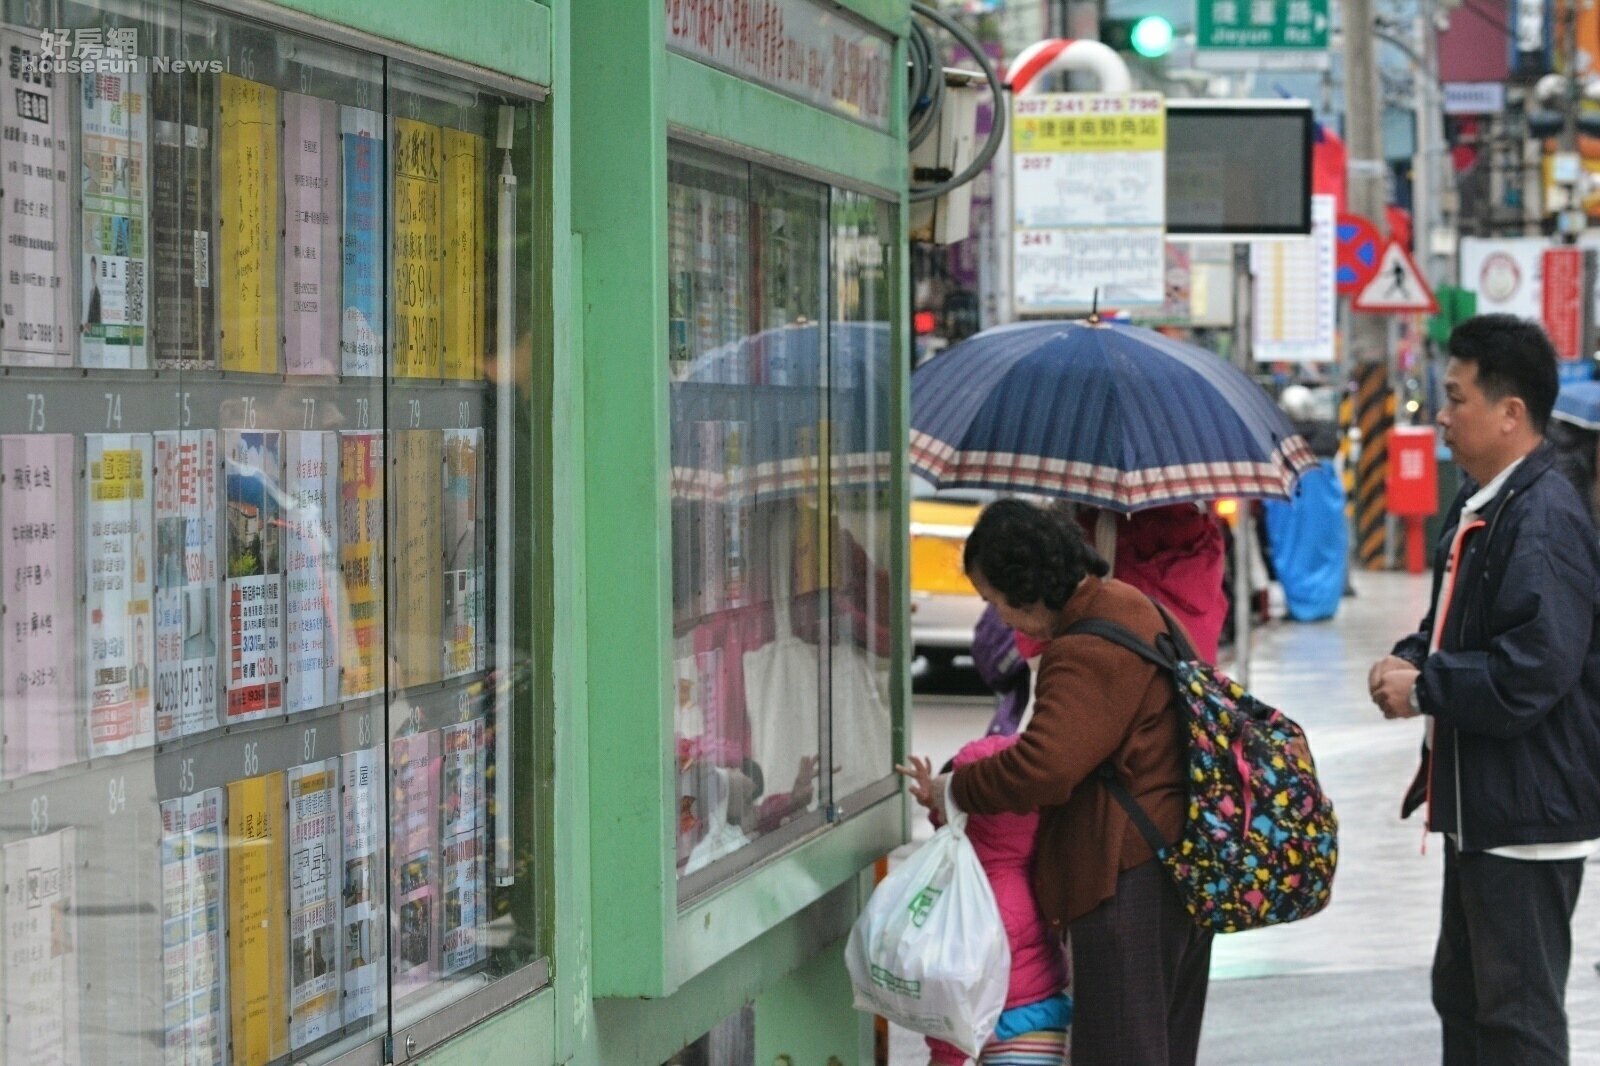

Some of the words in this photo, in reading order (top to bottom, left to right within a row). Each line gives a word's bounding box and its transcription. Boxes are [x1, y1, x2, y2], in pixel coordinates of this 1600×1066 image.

[1016, 99, 1048, 113] 207
[1054, 99, 1084, 112] 241
[1091, 98, 1122, 112] 275
[1022, 157, 1052, 170] 207
[1022, 233, 1051, 246] 241
[27, 394, 46, 432] 73
[105, 393, 122, 428] 74
[242, 397, 256, 429] 76
[301, 399, 315, 429] 77
[357, 399, 369, 428] 78
[408, 399, 421, 428] 79
[458, 402, 470, 428] 80
[358, 714, 371, 746] 88
[408, 707, 421, 735] 89
[244, 743, 259, 776] 86
[303, 728, 317, 761] 87
[108, 775, 126, 815] 84
[30, 795, 49, 835] 83
